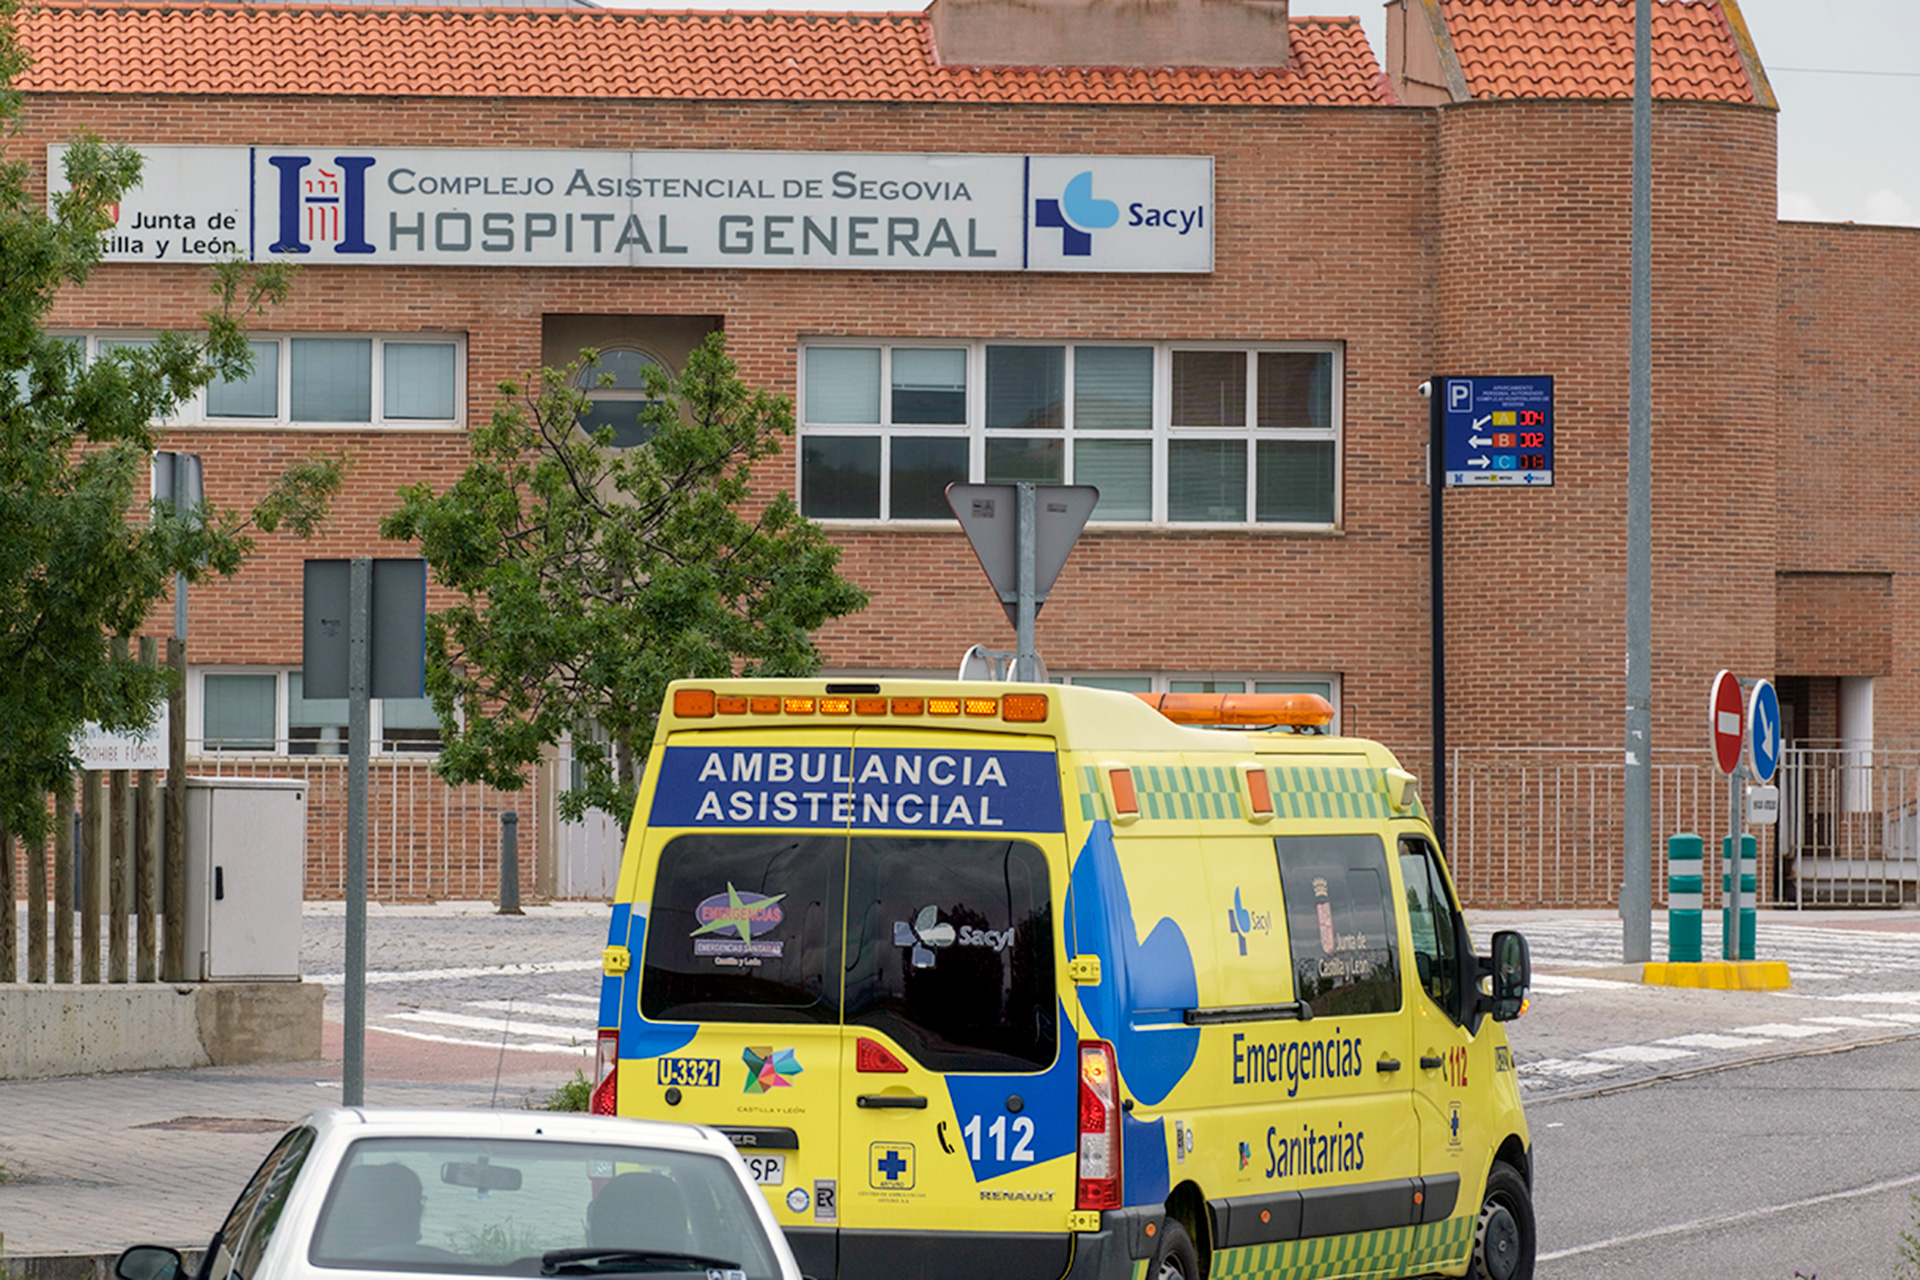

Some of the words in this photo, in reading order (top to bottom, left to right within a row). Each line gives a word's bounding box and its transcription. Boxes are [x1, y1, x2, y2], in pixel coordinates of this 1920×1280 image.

[387, 168, 554, 195] COMPLEJO
[564, 169, 775, 198] ASISTENCIAL
[783, 180, 823, 198] DE
[831, 171, 973, 201] SEGOVIA
[131, 212, 196, 230] Junta
[208, 212, 236, 230] de
[1128, 203, 1203, 235] Sacyl
[389, 211, 688, 254] HOSPITAL
[719, 215, 997, 258] GENERAL
[102, 236, 144, 253] tilla
[155, 239, 170, 259] y
[182, 237, 236, 254] León
[1451, 385, 1469, 408] P
[1498, 413, 1510, 425] A
[1498, 433, 1510, 447] B
[1498, 456, 1510, 469] C
[79, 746, 119, 761] PROHIBE
[125, 746, 158, 762] FUMAR
[698, 753, 1008, 787] AMBULANCIA
[695, 791, 1004, 825] ASISTENCIAL
[701, 906, 781, 922] EMERGENCIAS
[1251, 911, 1272, 935] Sacyl
[959, 925, 1015, 952] Sacyl
[1336, 933, 1355, 950] Junta
[1356, 931, 1367, 950] de
[1318, 958, 1345, 978] Castilla
[660, 1059, 718, 1086] U-3321
[1233, 1027, 1362, 1098] Emergencias
[1449, 1046, 1468, 1087] 112
[736, 1106, 775, 1114] CASTILLA
[783, 1106, 806, 1114] LEÓN
[964, 1115, 1035, 1162] 112
[1265, 1121, 1364, 1179] Sanitarias
[743, 1157, 778, 1181] SP
[979, 1190, 1056, 1202] RENAULT
